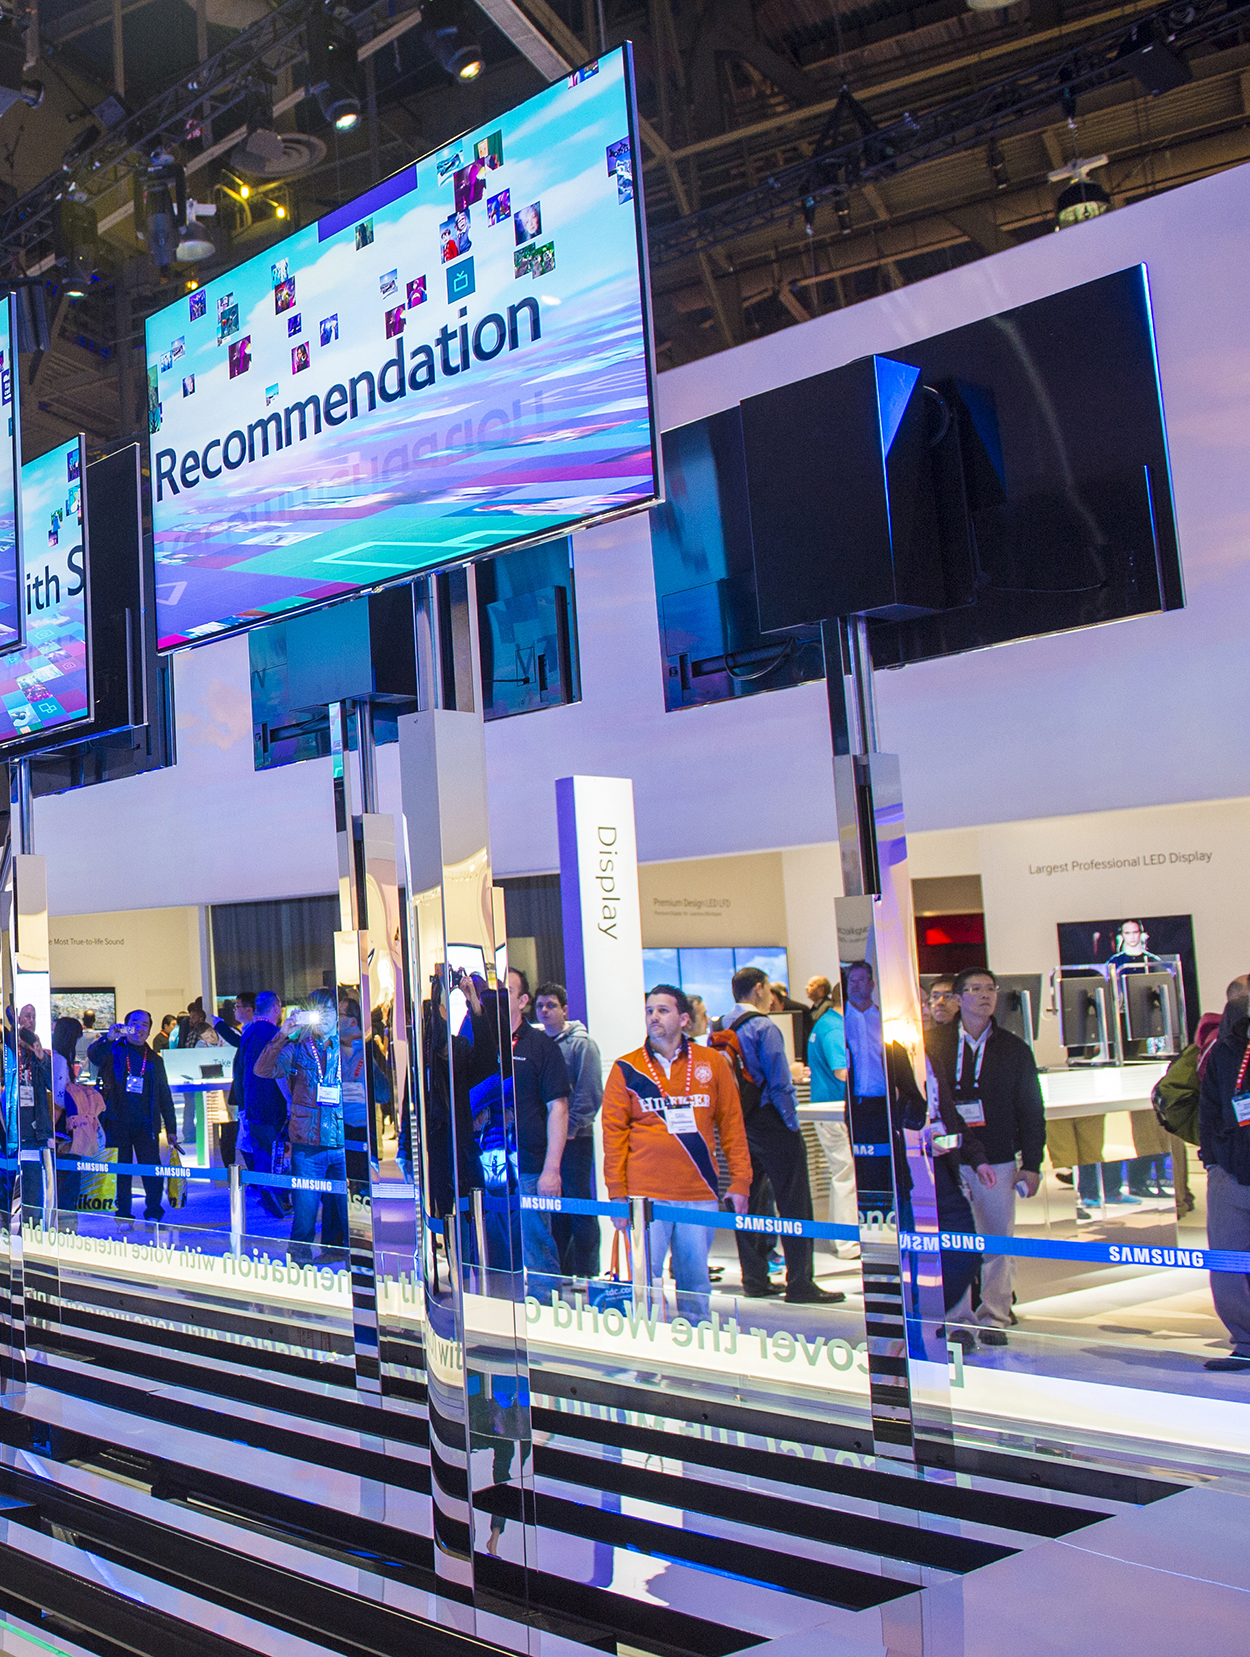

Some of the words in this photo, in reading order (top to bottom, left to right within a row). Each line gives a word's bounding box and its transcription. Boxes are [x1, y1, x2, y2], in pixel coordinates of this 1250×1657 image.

[155, 296, 542, 502] Recommendation
[26, 561, 60, 616] ith
[1029, 862, 1069, 876] Largest
[1072, 856, 1141, 871] Professional
[1143, 853, 1166, 866] LED
[1169, 851, 1212, 864] Display
[595, 826, 621, 940] Display
[53, 938, 69, 946] Most
[104, 937, 125, 946] Sound
[77, 1162, 109, 1173] SAMSUNG
[155, 1166, 191, 1178] SAMSUNG
[291, 1178, 332, 1192] SAMSUNG
[76, 1194, 114, 1210] ikon
[520, 1196, 561, 1211] MSUNG
[735, 1216, 803, 1235] SAMSUNG
[941, 1234, 985, 1251] SUNG
[1109, 1246, 1204, 1267] SAMSUNG
